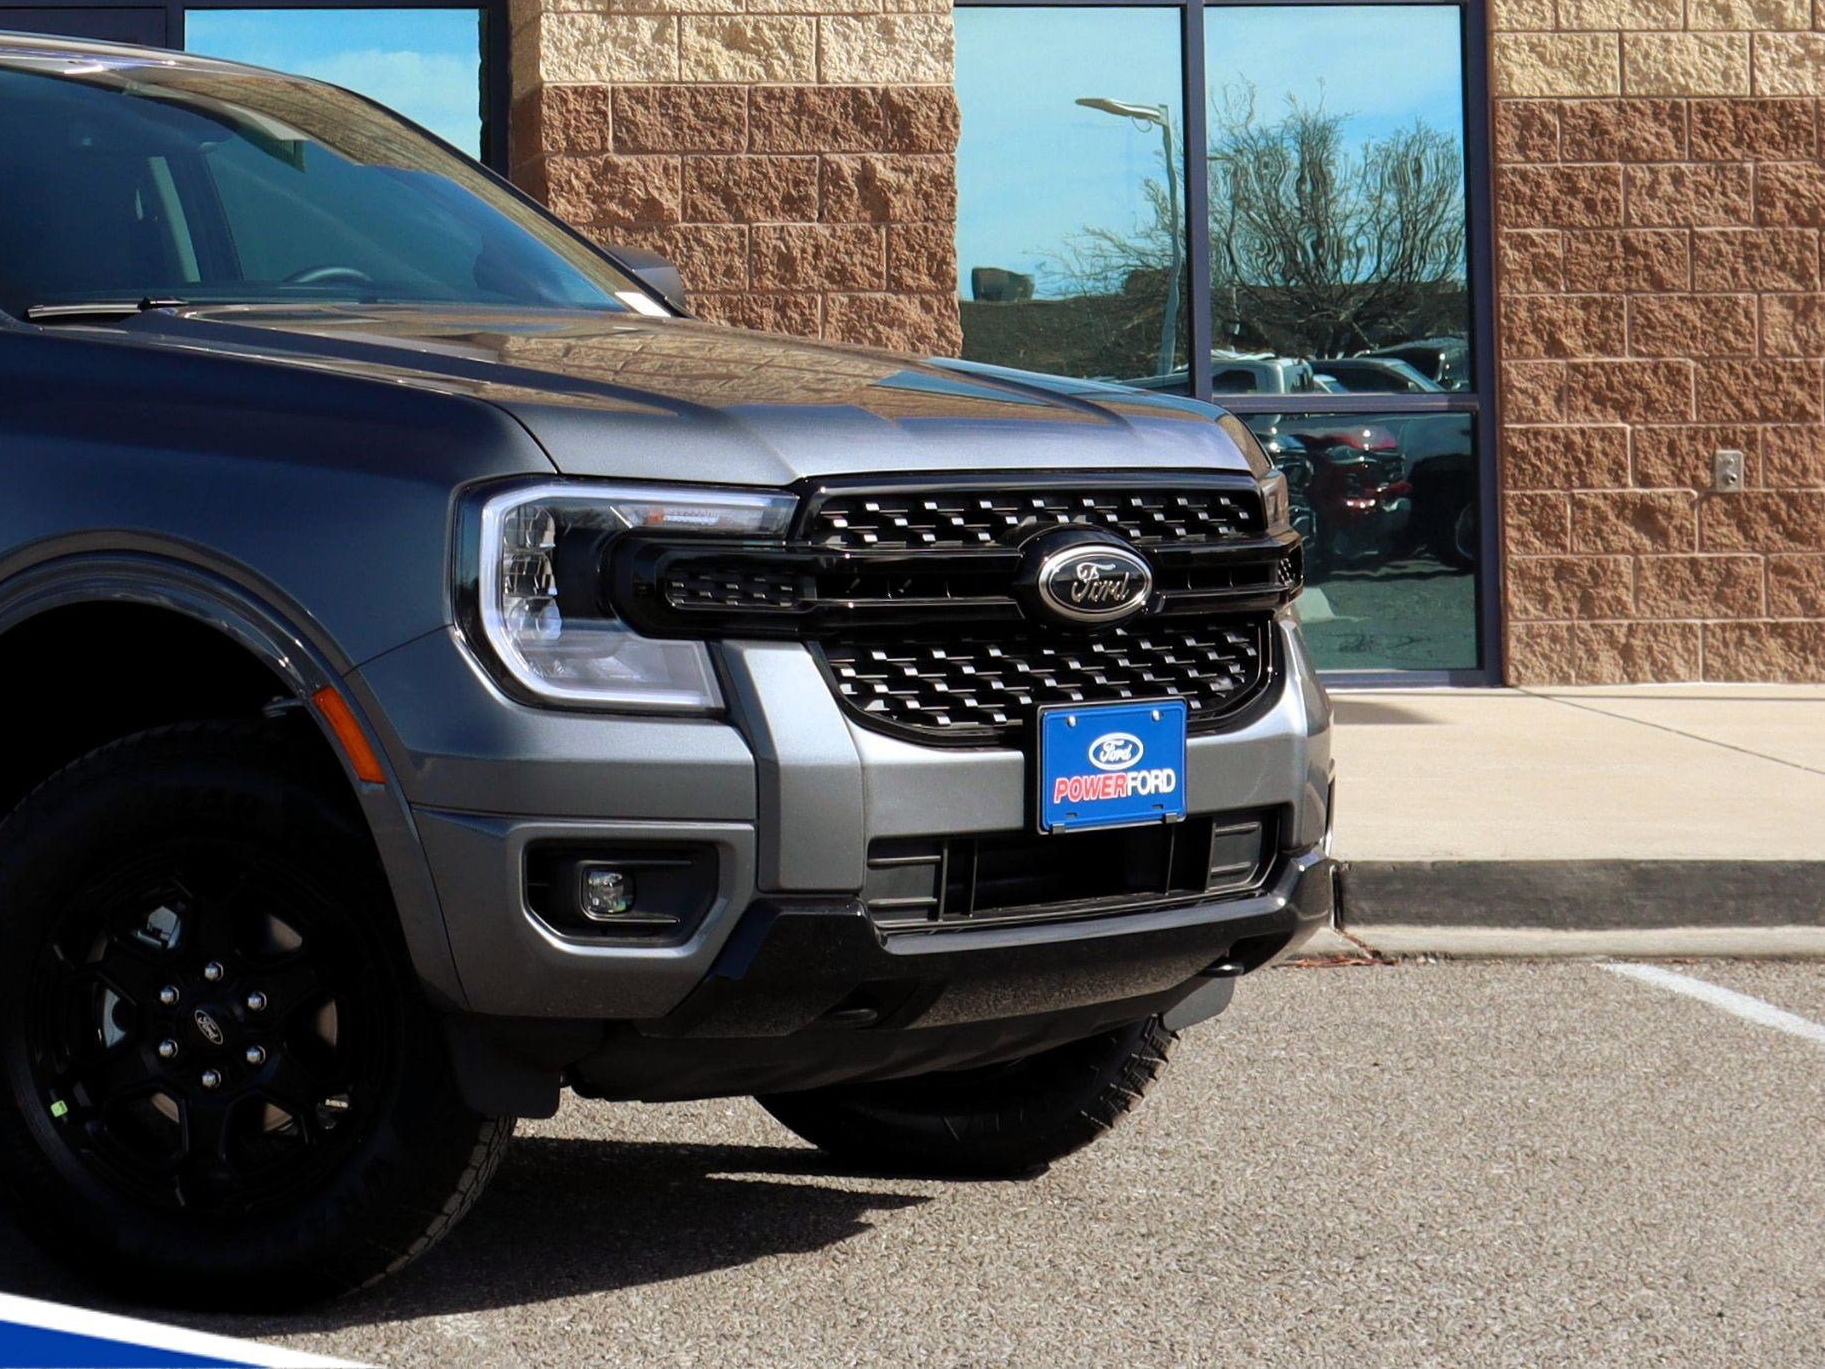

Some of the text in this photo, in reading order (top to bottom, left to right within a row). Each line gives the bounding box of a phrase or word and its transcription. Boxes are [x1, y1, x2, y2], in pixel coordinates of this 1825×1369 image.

[1070, 562, 1131, 603] Ford
[1099, 737, 1133, 764] Ford
[1053, 769, 1176, 803] POWERFORD
